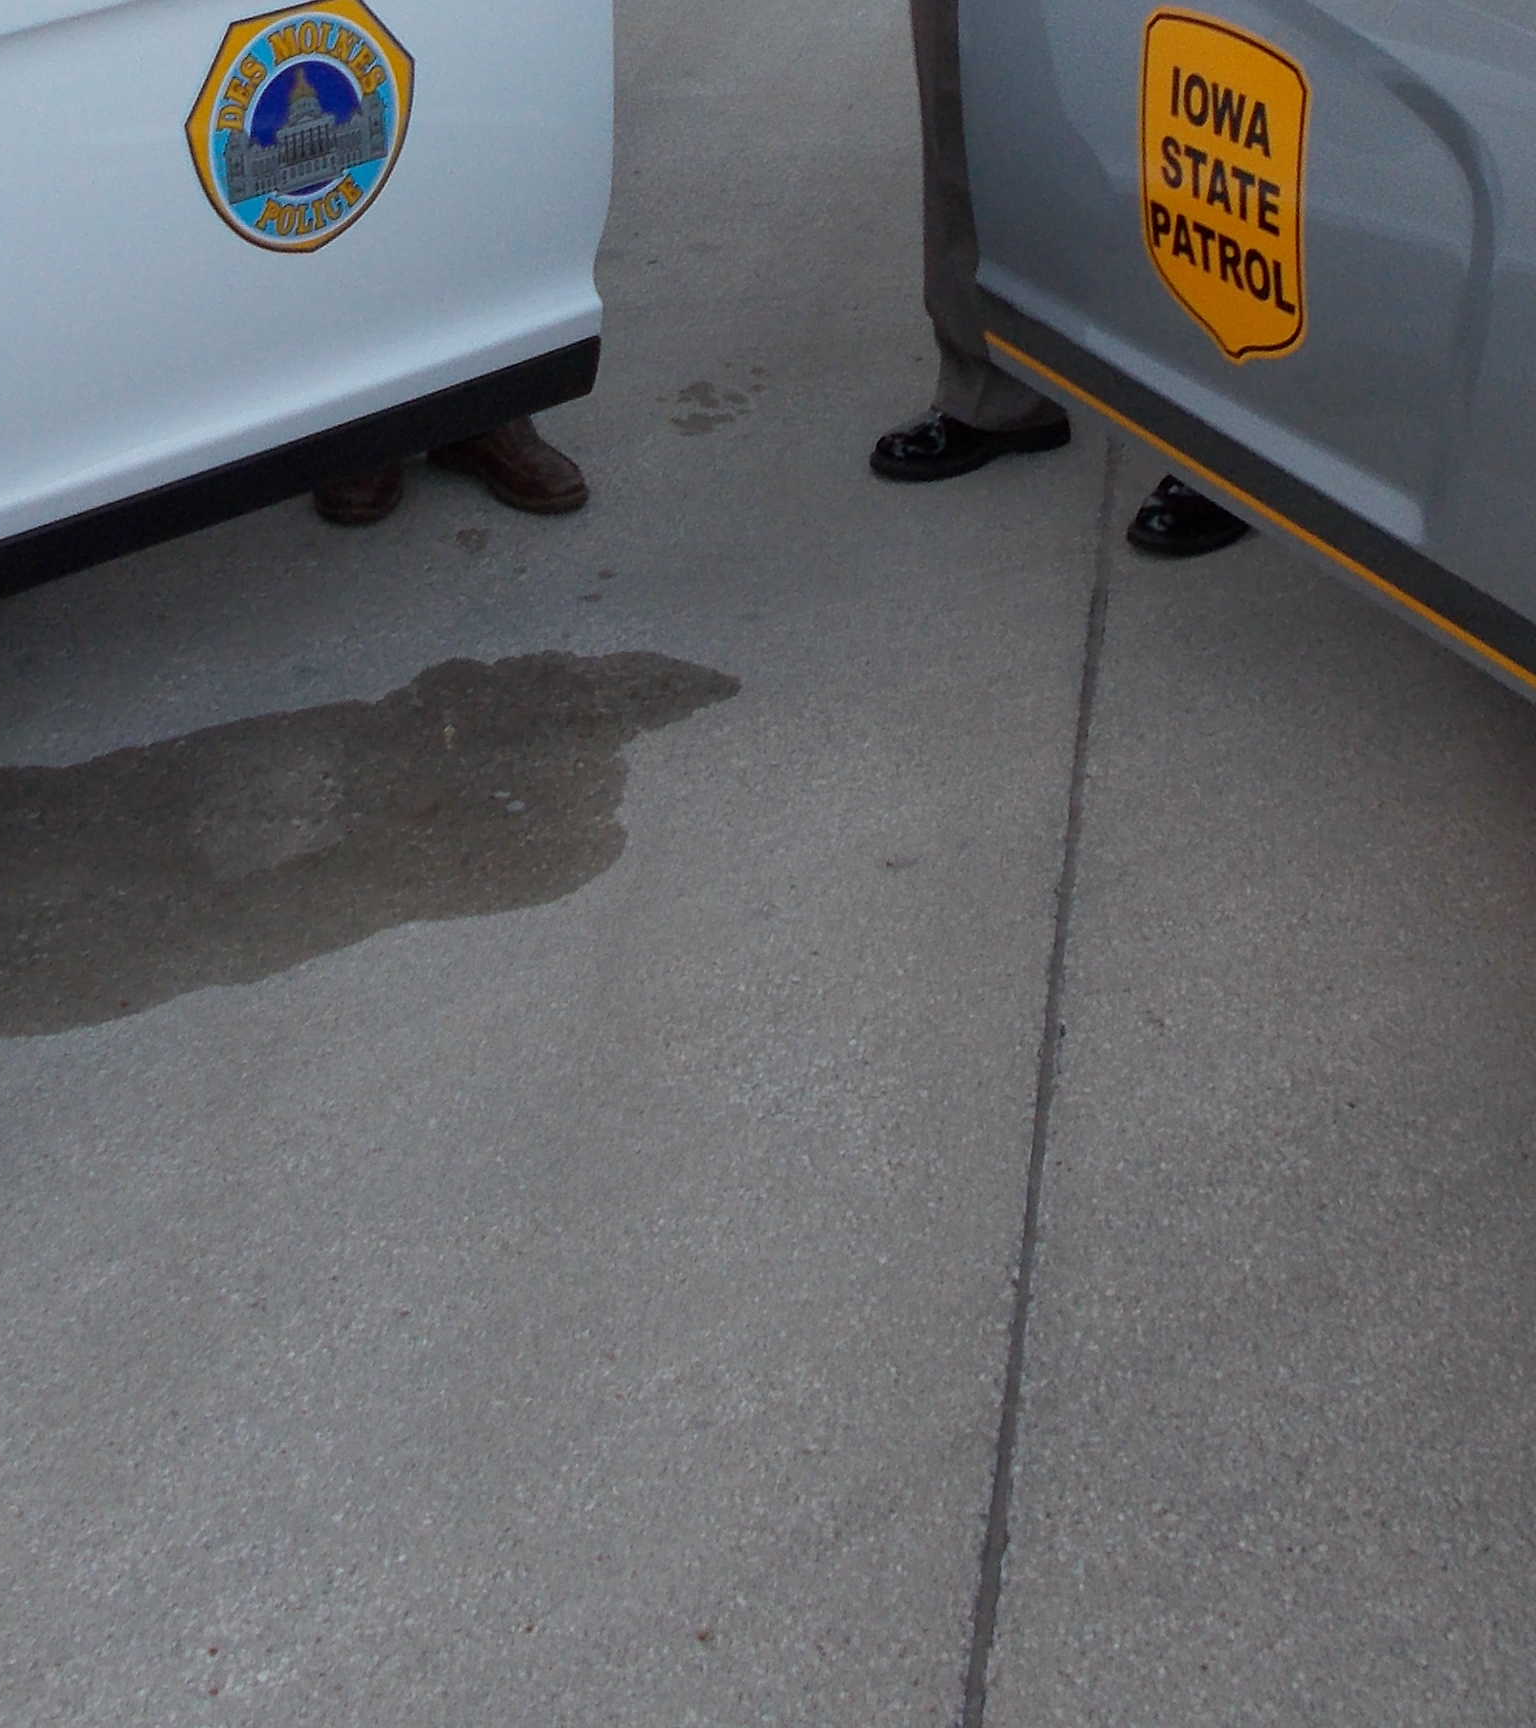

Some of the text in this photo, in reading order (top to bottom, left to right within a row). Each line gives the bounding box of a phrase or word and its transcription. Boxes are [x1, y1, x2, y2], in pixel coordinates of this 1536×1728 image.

[216, 20, 388, 133] DES MOINES
[1170, 66, 1270, 158] IOWA
[256, 174, 365, 236] POLICE
[1161, 135, 1280, 236] STATE
[1149, 200, 1296, 315] PATROL
